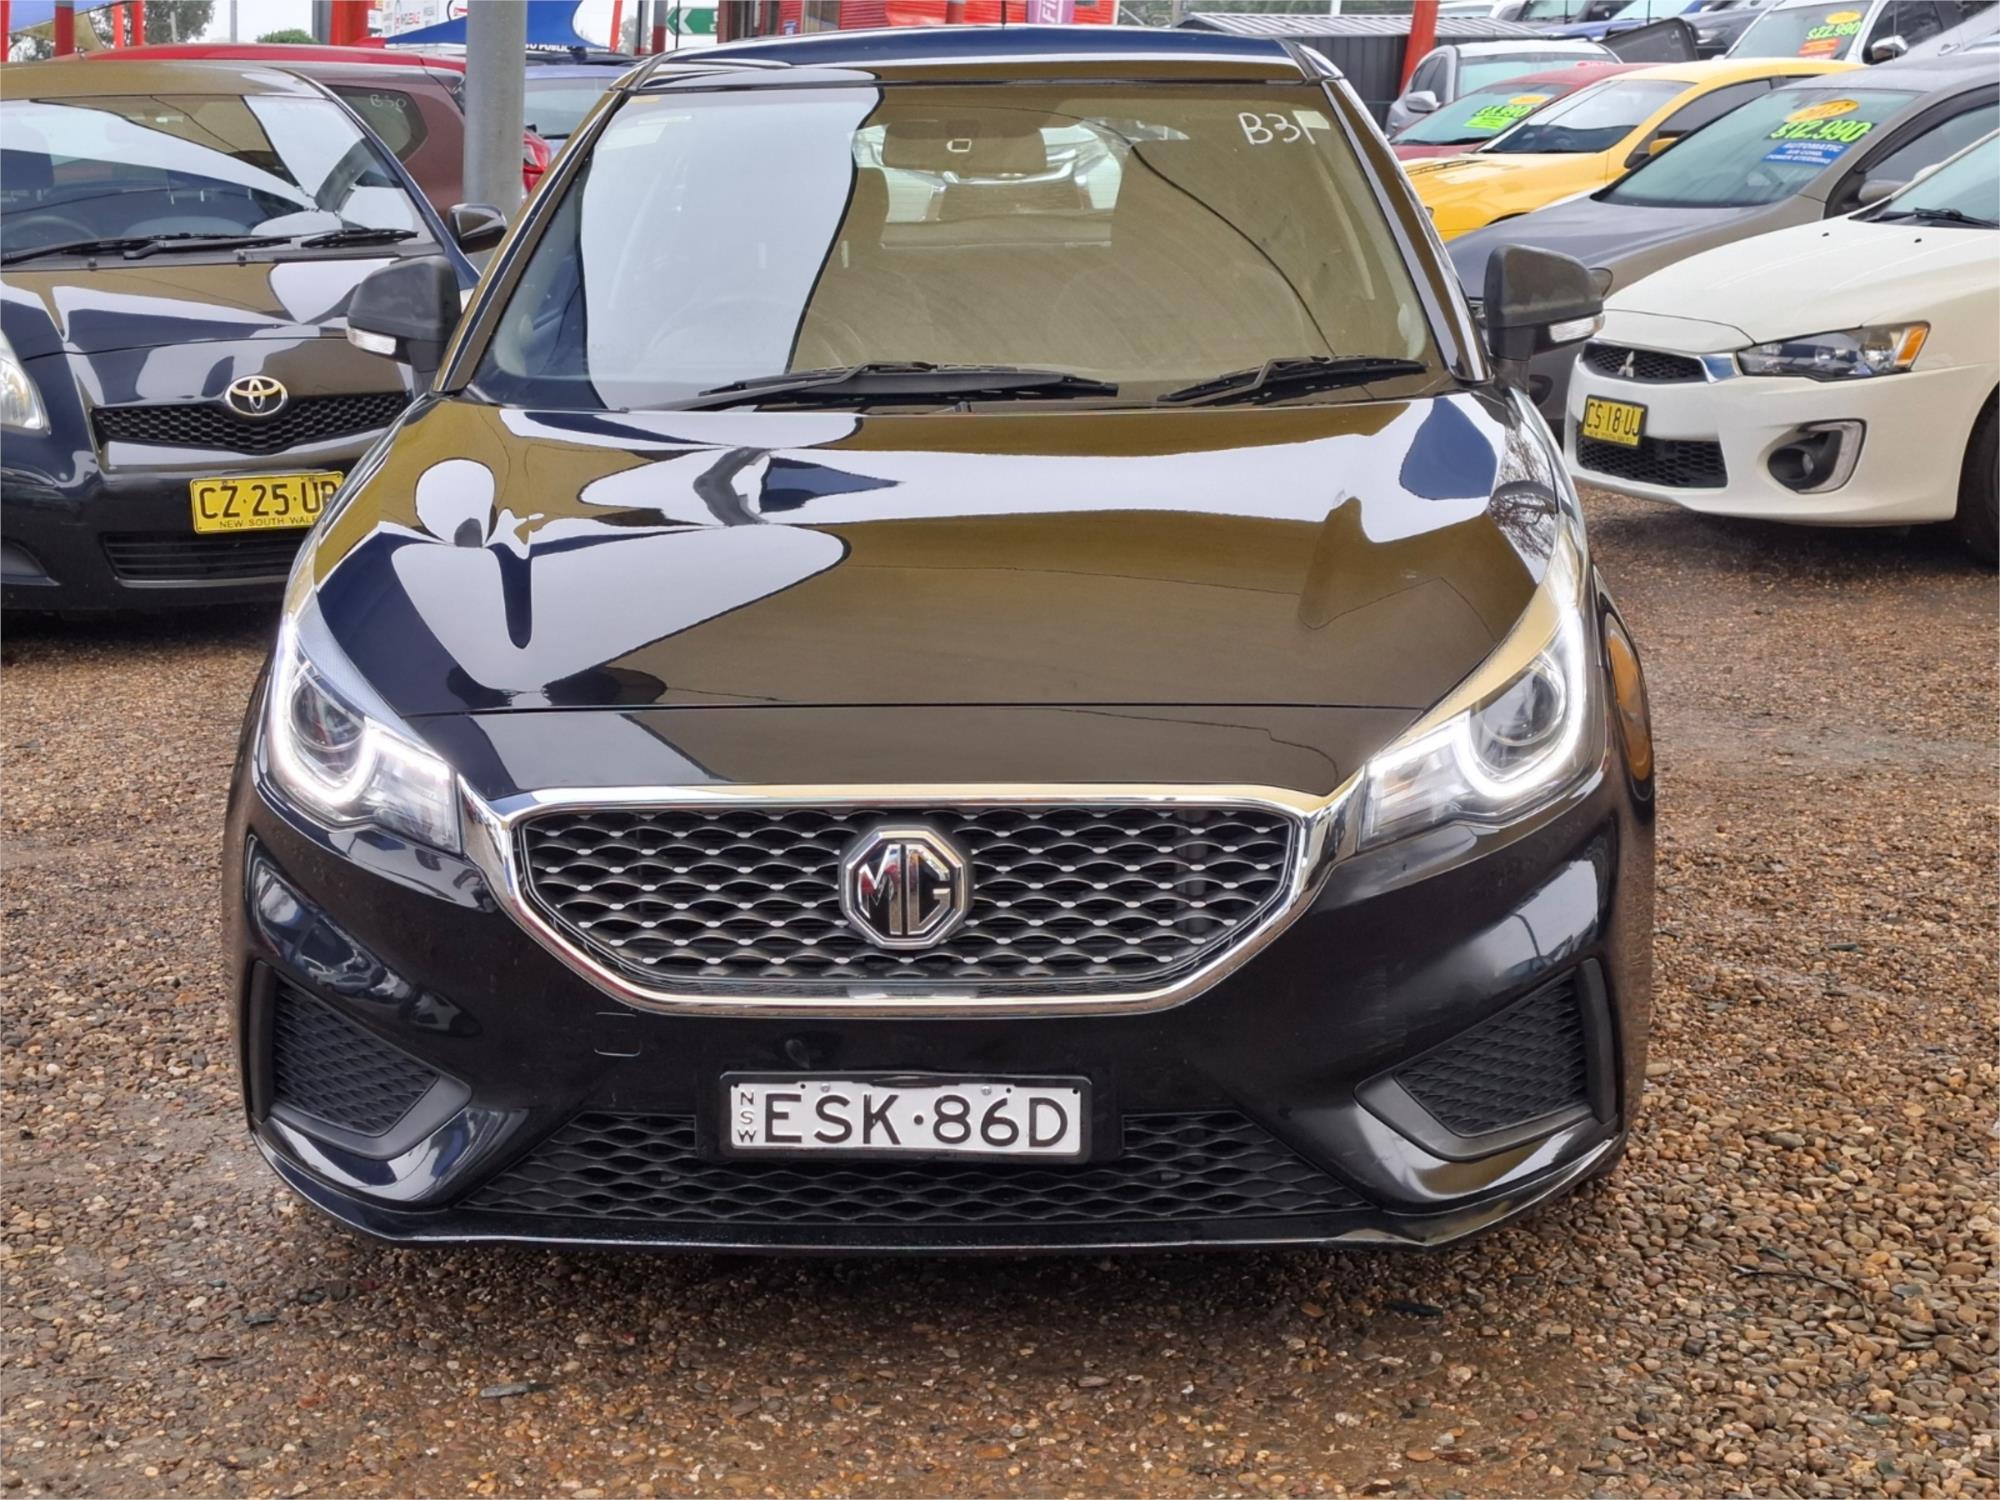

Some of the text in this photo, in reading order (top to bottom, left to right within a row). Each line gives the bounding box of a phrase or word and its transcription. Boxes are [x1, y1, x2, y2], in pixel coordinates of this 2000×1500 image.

[1238, 110, 1316, 145] B31
[219, 515, 319, 529] NEW SOUTH WALE
[858, 844, 951, 935] MG
[737, 1091, 757, 1143] NSW
